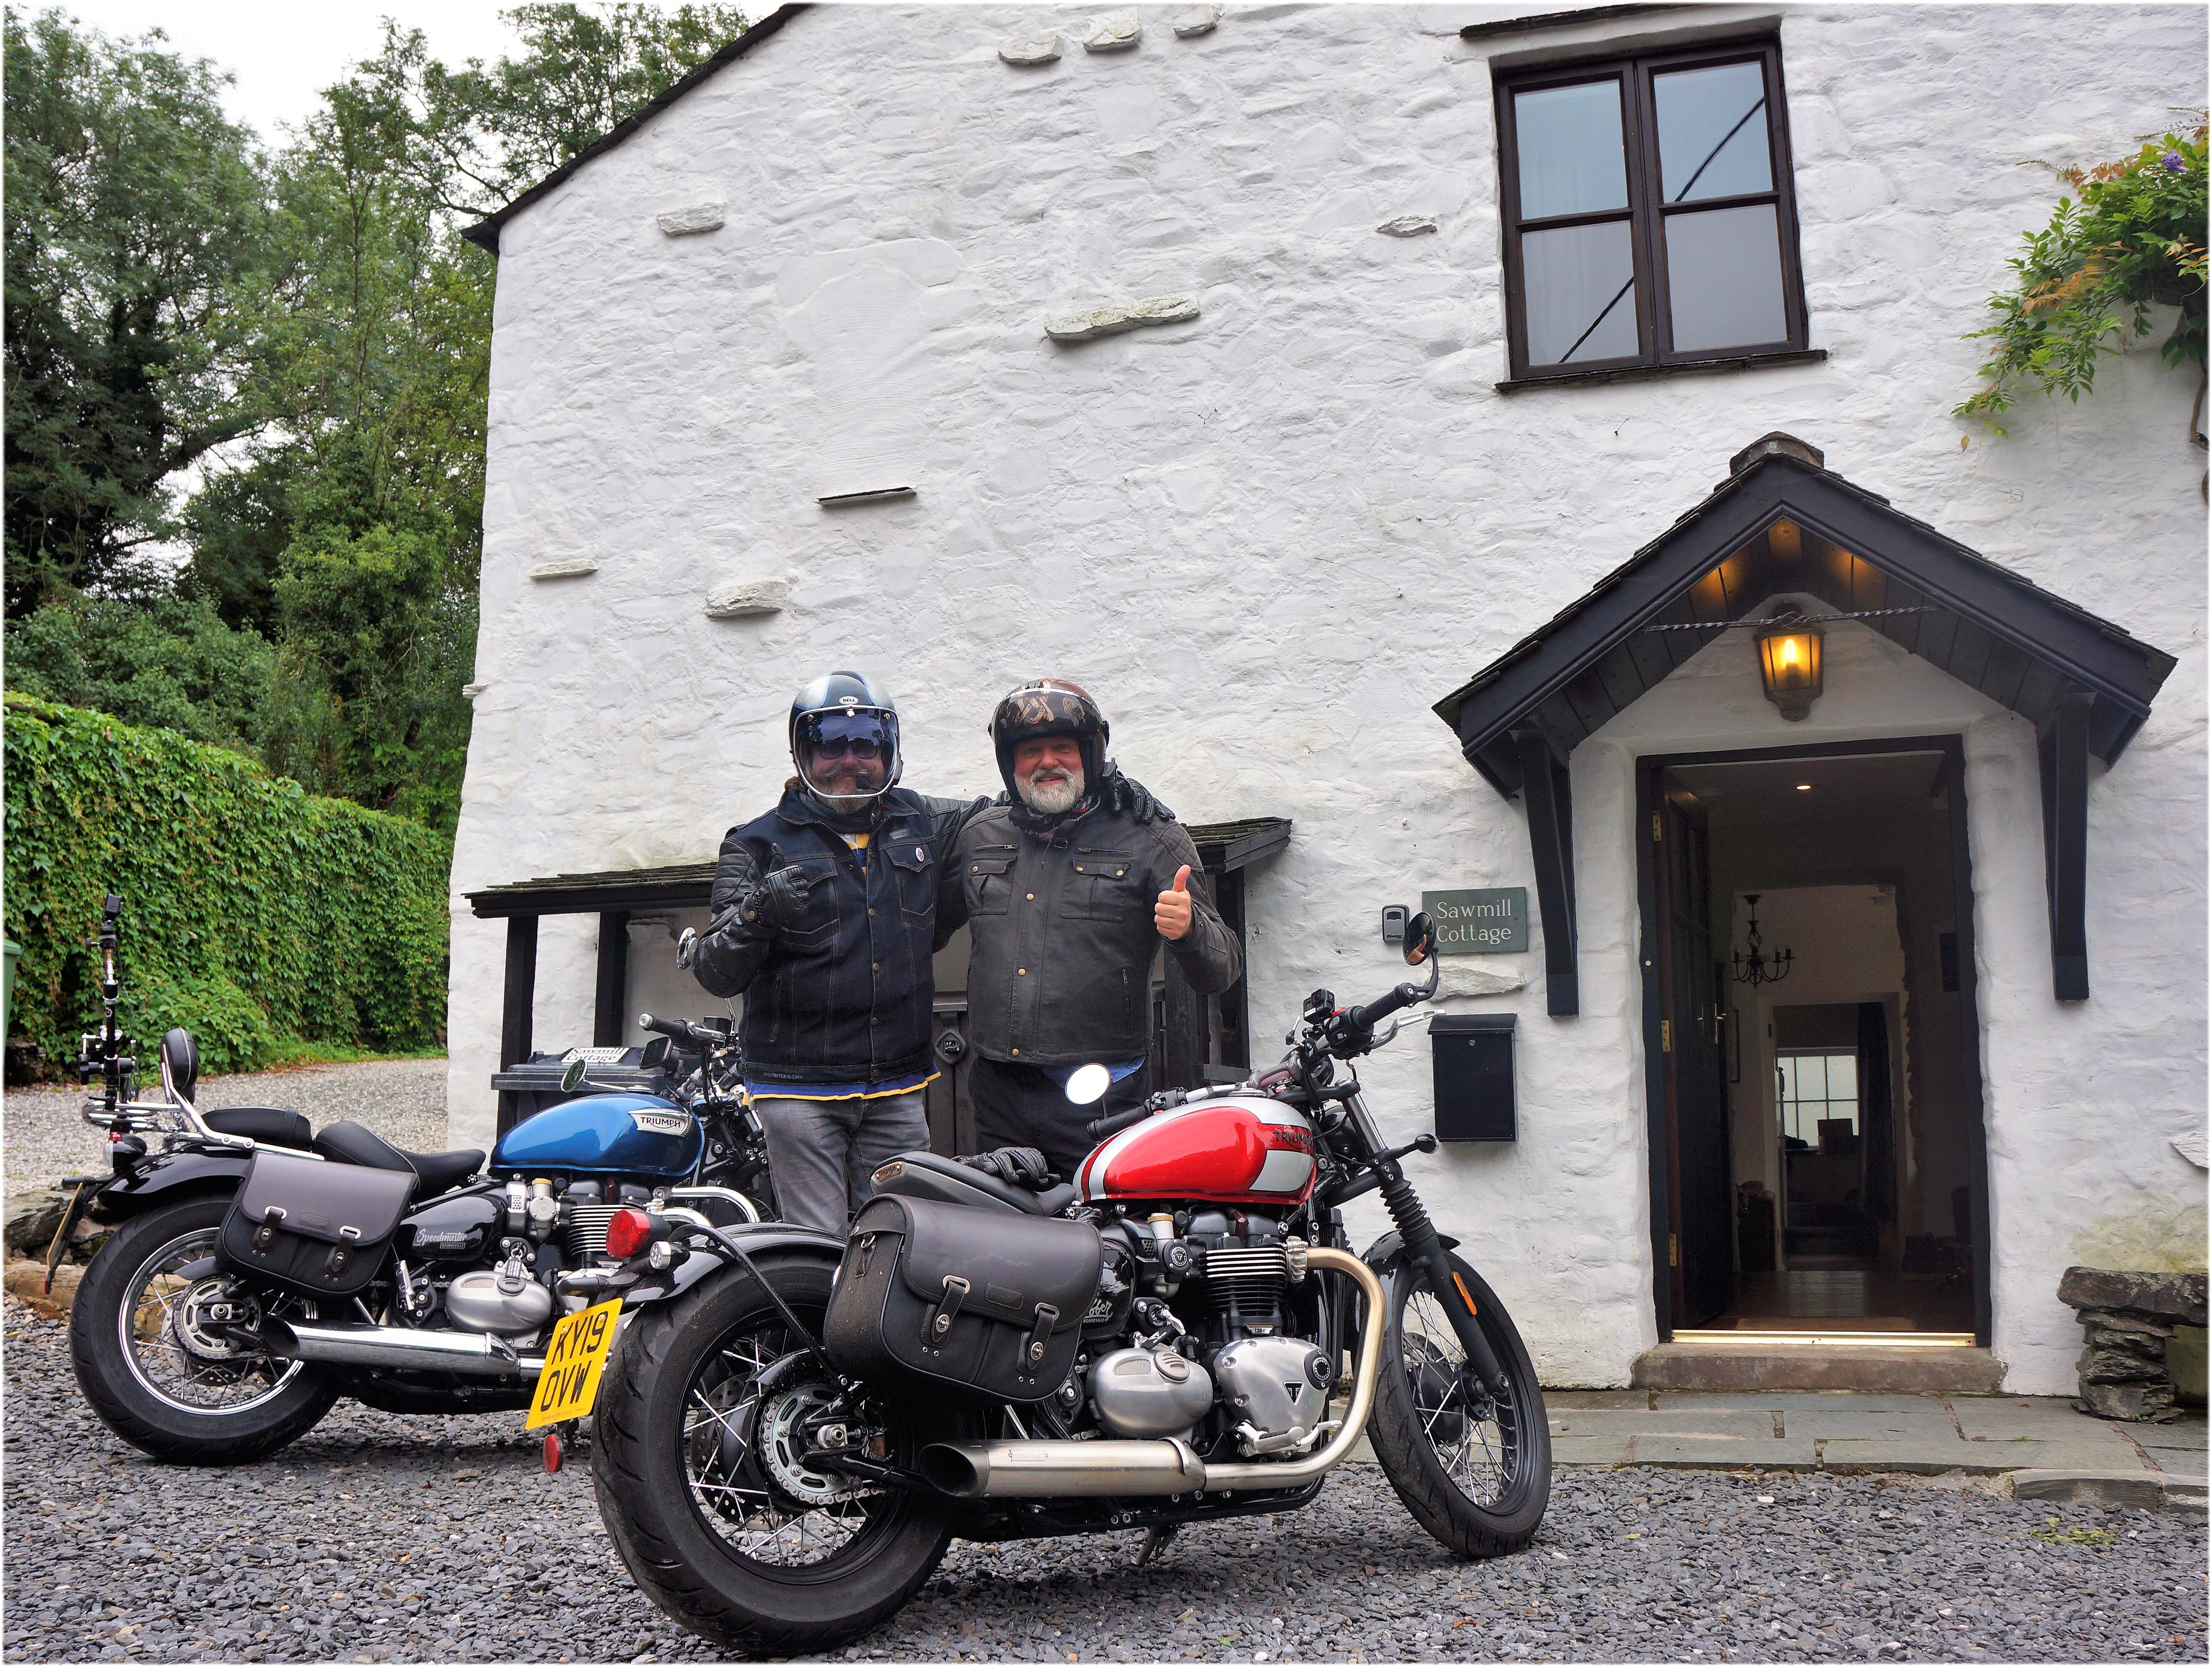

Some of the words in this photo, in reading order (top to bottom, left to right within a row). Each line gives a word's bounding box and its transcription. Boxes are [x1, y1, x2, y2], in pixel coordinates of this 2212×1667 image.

[1437, 899, 1511, 919] Sawmill
[1436, 924, 1511, 945] Cottage
[567, 1054, 616, 1063] Cottage
[641, 1117, 680, 1128] TRIUMPH
[417, 1228, 467, 1247] Speedmaster
[551, 1311, 608, 1365] KY19
[540, 1360, 592, 1412] OVW
